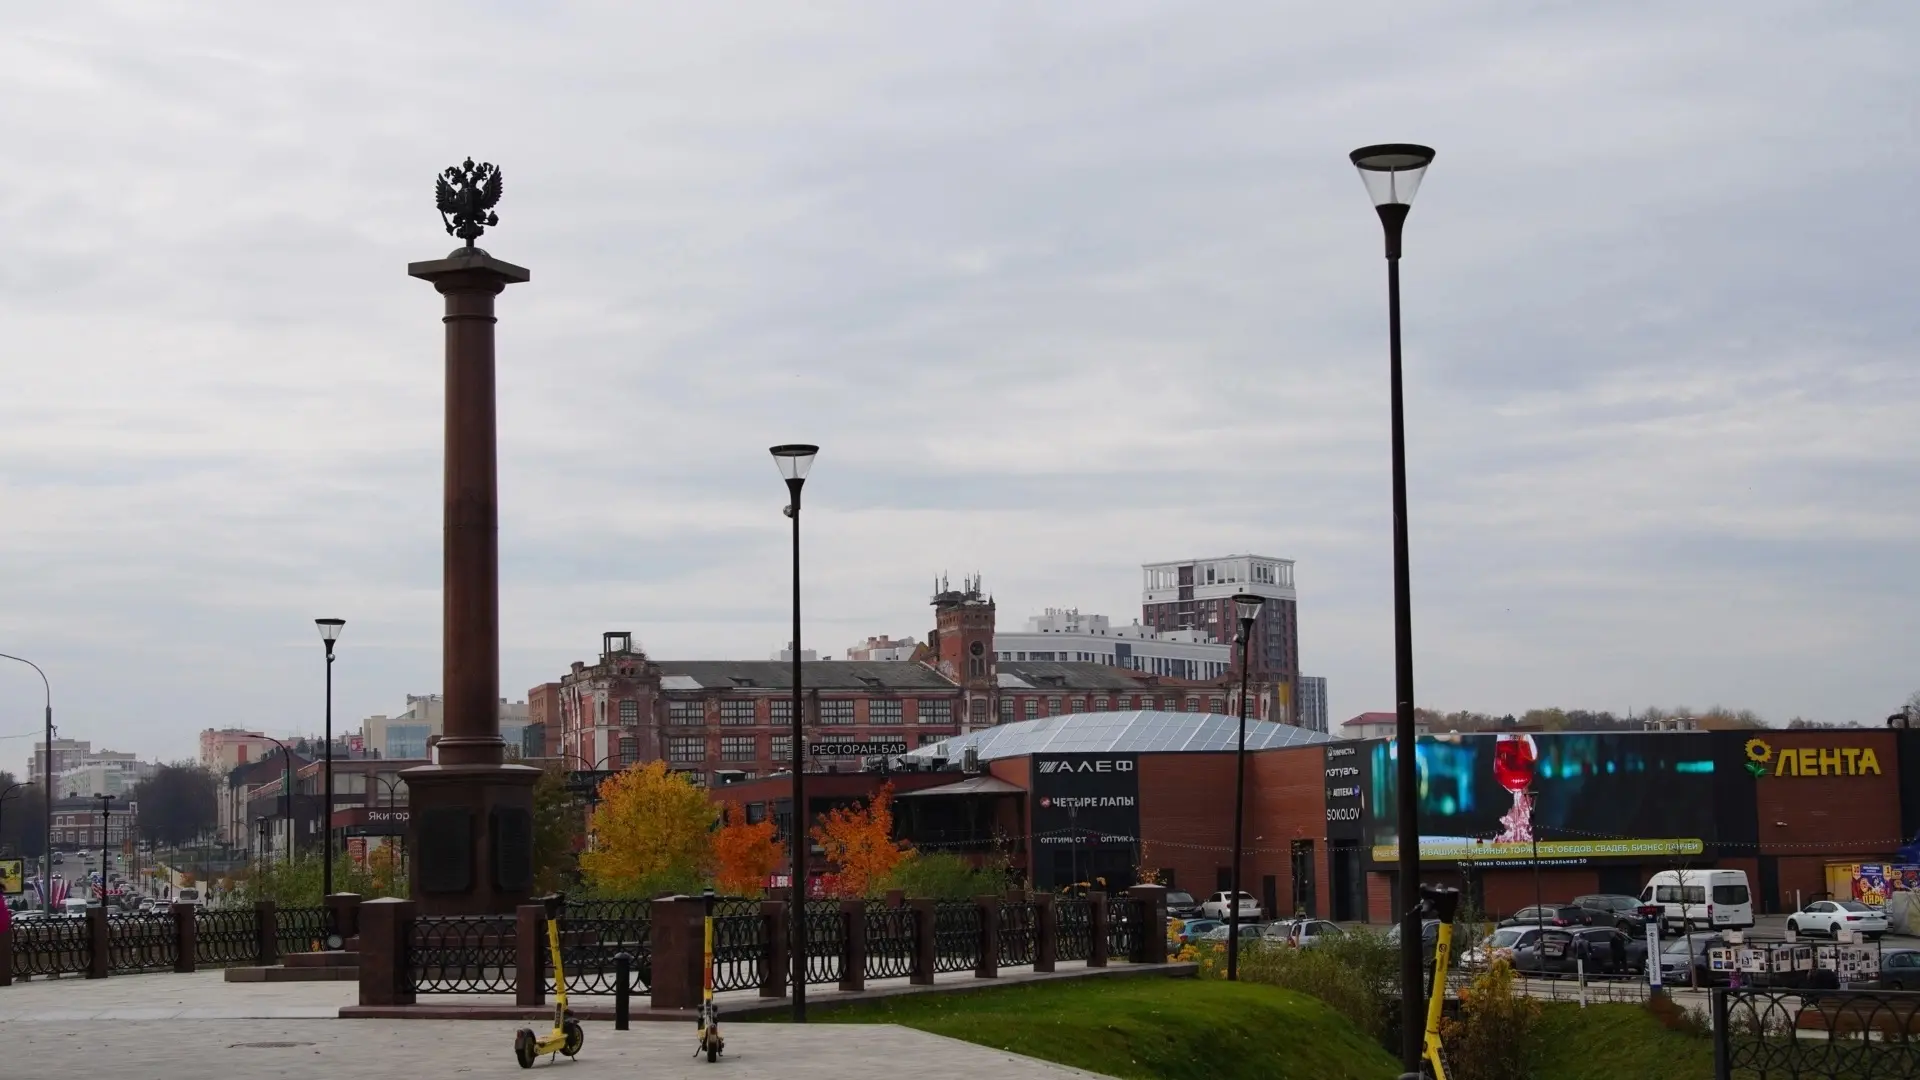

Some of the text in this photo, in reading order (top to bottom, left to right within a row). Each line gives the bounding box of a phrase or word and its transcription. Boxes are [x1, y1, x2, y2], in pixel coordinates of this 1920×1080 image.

[811, 743, 906, 755] РЕСТОРАН-БАР
[1056, 760, 1133, 773] АЛЕФ
[1774, 747, 1882, 777] ЛЕНТА
[1332, 787, 1354, 798] АПТЕКА
[1052, 796, 1135, 808] ЧЕТЫРЕ ЛАПЫ
[1326, 807, 1360, 821] SOKOLOV
[1100, 835, 1135, 843] ОПТИКА
[1427, 848, 1458, 856] ВАШИХ
[1460, 847, 1507, 855] СЕМЕЙНЫХ
[1594, 843, 1629, 853] СВАДЕБ,
[1631, 843, 1663, 852] БИЗНЕС
